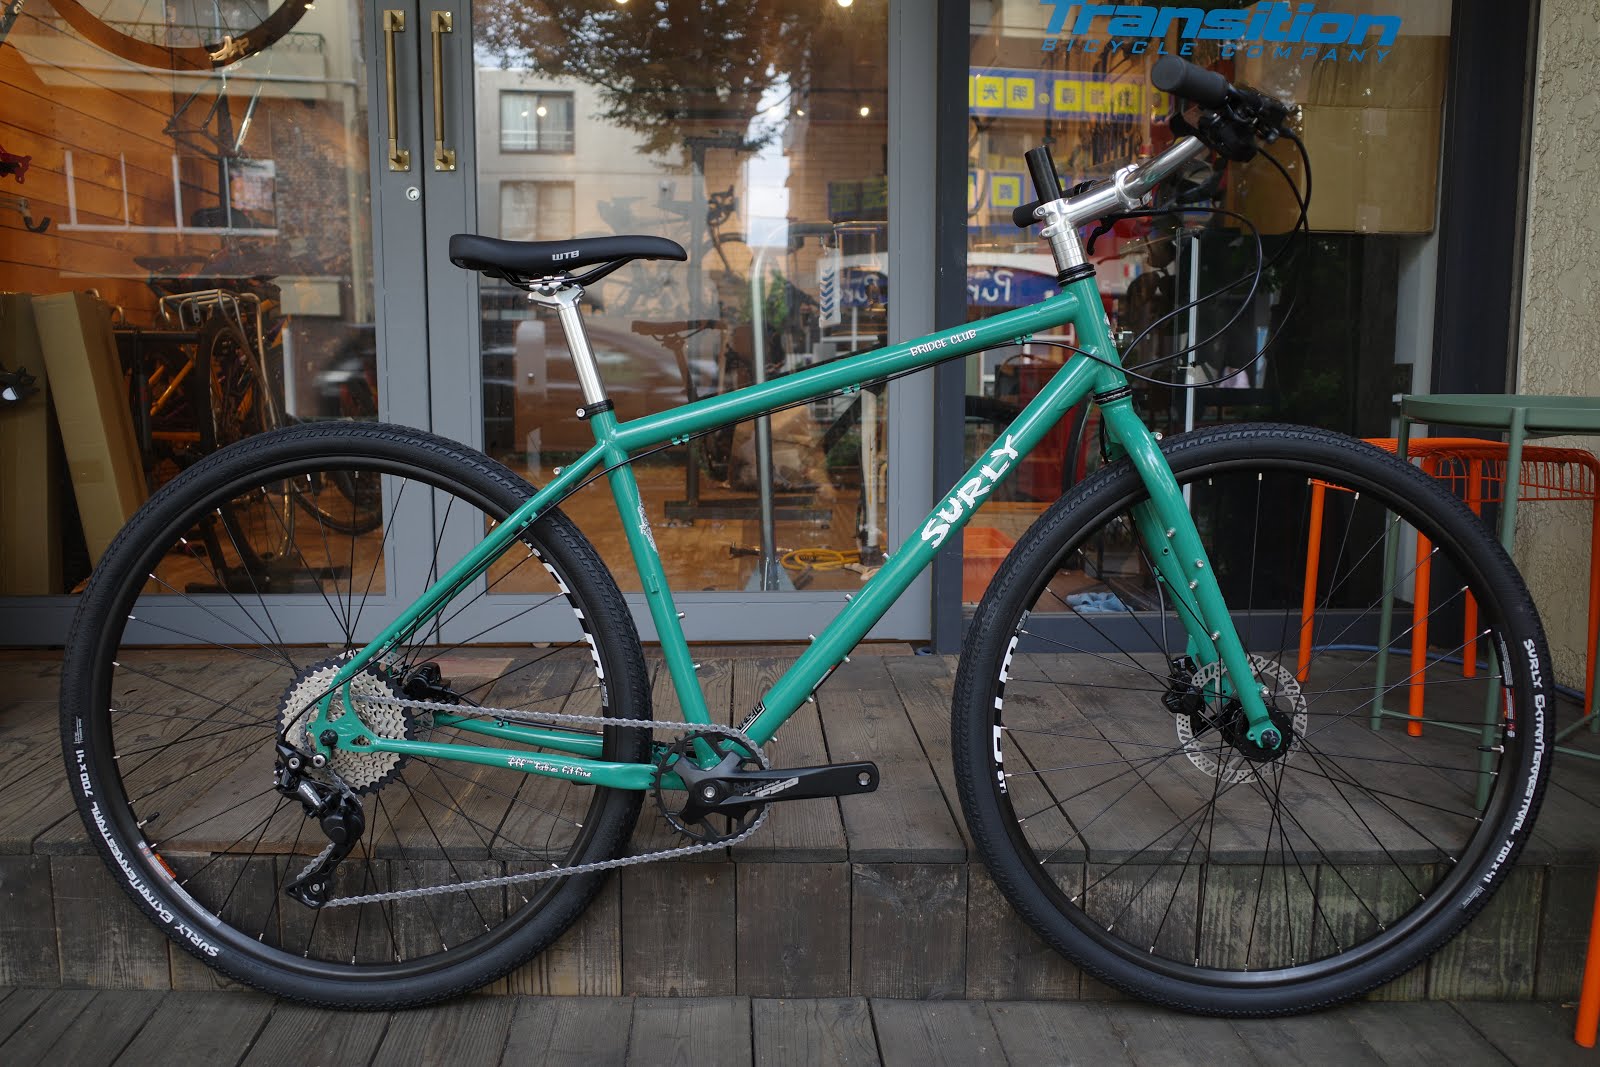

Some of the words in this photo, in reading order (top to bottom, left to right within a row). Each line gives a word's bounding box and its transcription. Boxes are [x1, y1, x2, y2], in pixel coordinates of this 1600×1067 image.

[1039, 0, 1402, 46] Transition
[1041, 38, 1198, 56] BICYCLE
[1221, 45, 1392, 63] COMPANY
[551, 250, 580, 261] WTB
[910, 338, 948, 357] BRIDGE
[950, 329, 977, 345] CLUB
[921, 434, 1019, 549] SURLY
[1523, 638, 1543, 688] SURLY
[173, 923, 220, 958] SURLY
